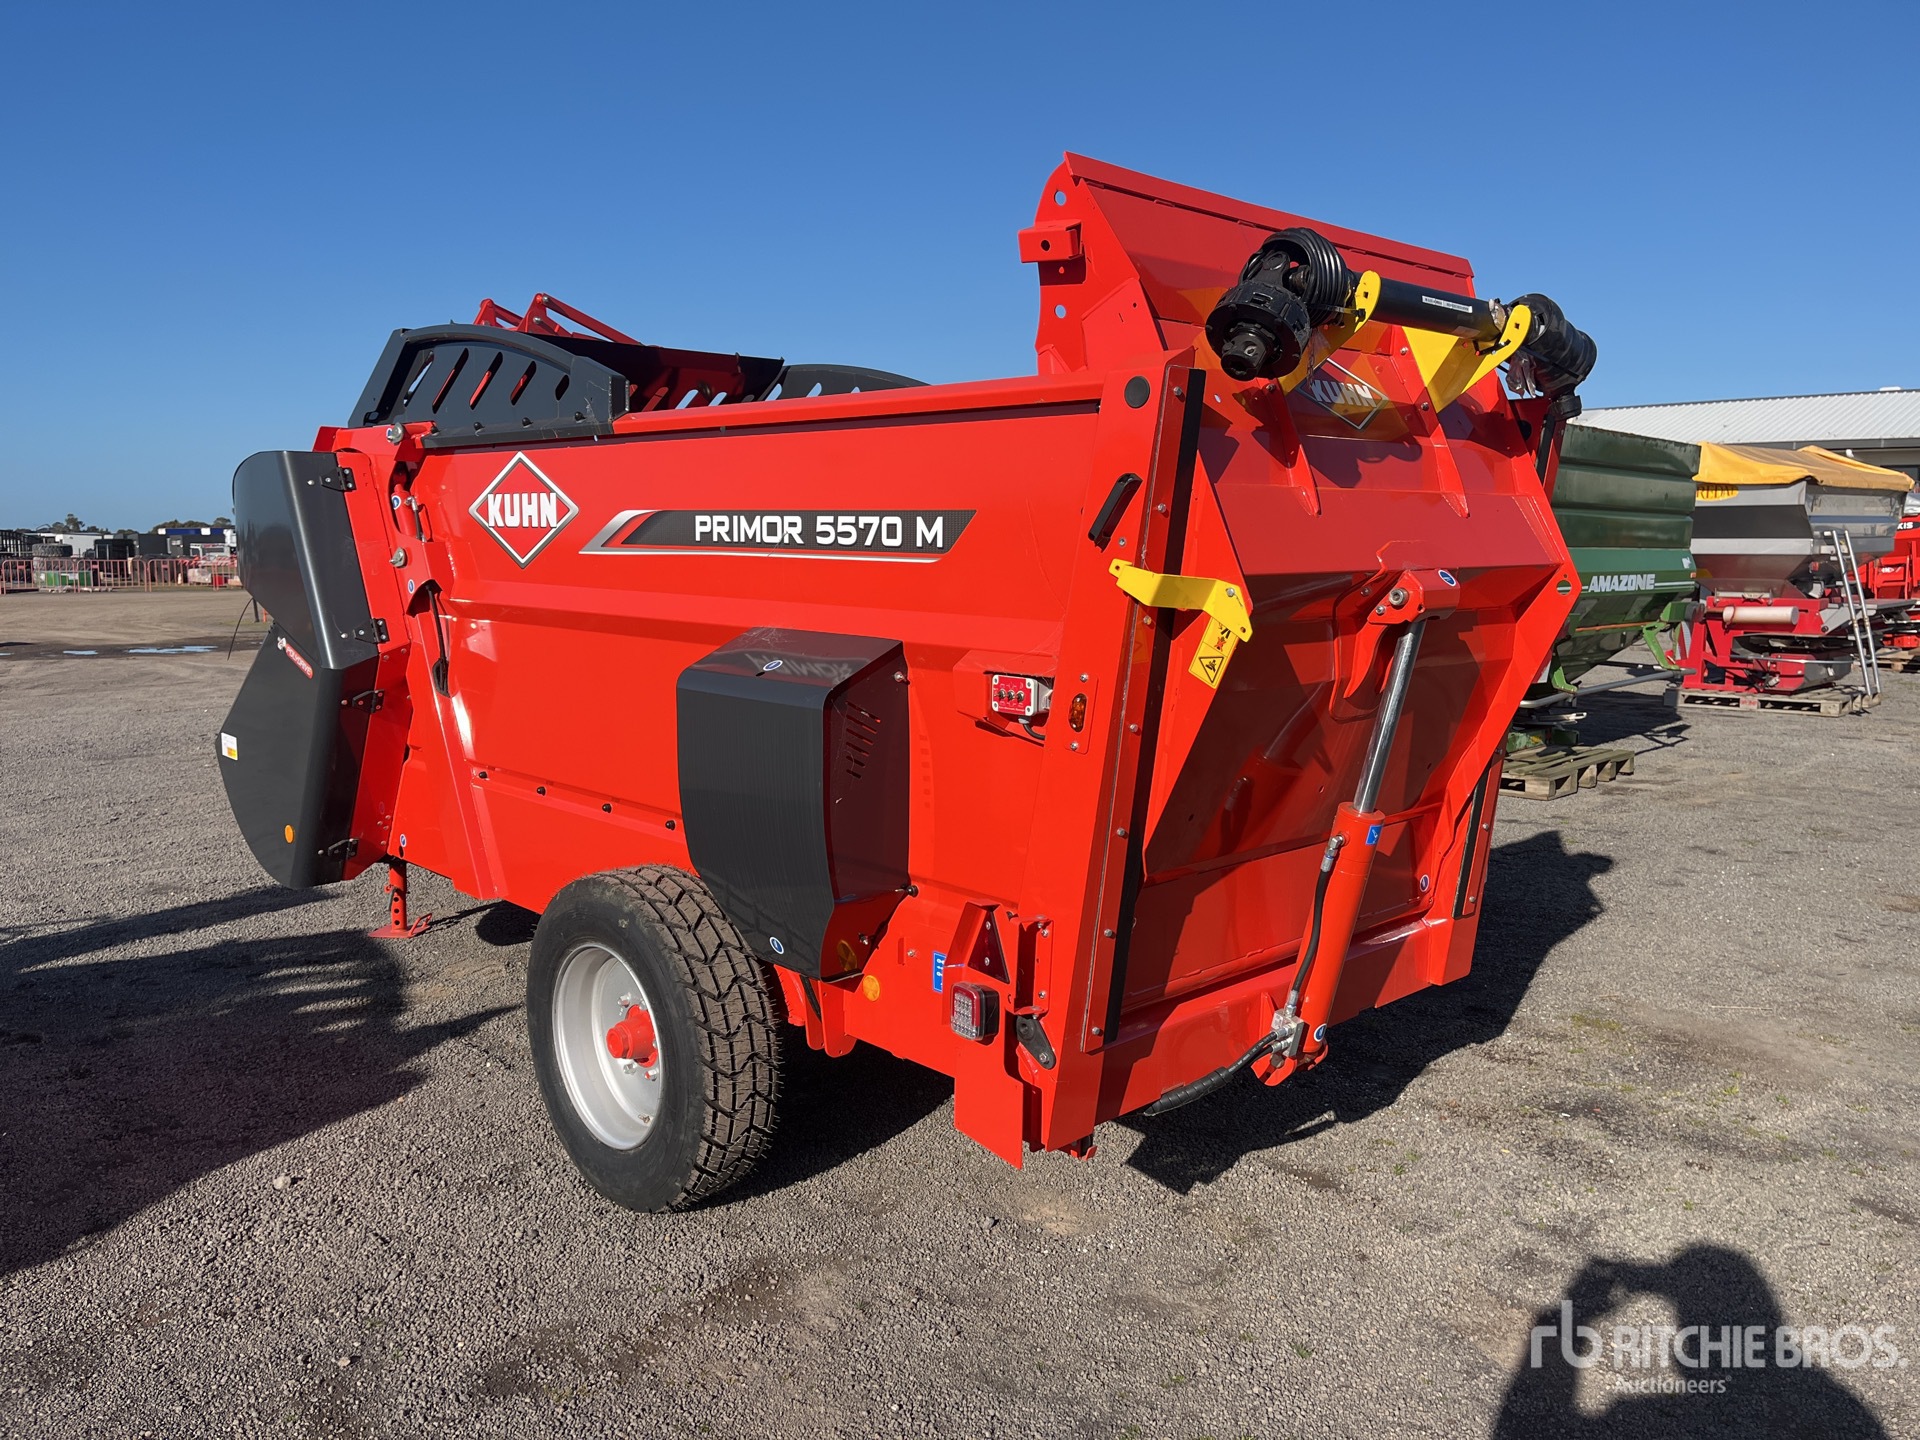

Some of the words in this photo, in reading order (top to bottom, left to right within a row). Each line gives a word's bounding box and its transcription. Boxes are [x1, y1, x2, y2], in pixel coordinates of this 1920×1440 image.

[1311, 380, 1377, 408] KUHN
[487, 492, 558, 528] KUHN
[695, 515, 804, 545] PRIMOR
[815, 516, 904, 547] 5570
[915, 516, 944, 548] M
[1588, 573, 1656, 593] AMAZONE
